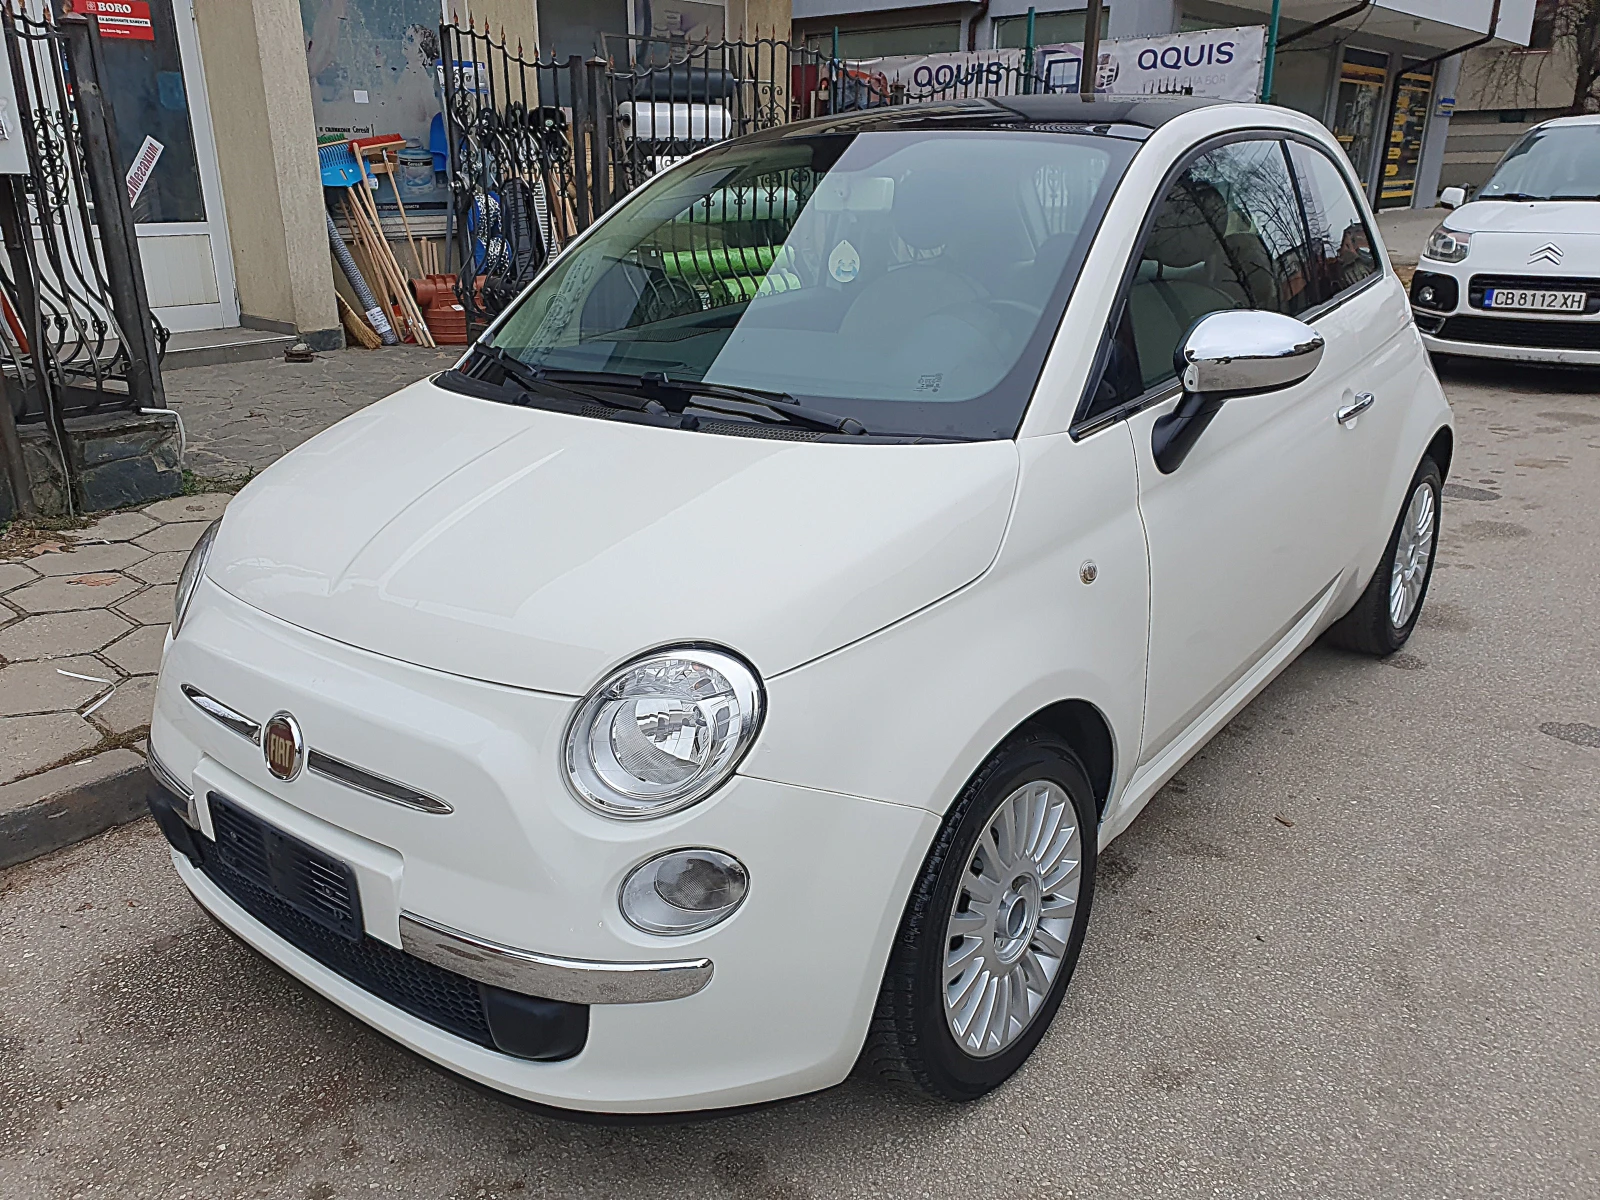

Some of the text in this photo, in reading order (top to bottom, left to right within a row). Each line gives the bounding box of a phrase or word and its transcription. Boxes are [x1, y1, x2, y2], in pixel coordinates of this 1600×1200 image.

[97, 2, 132, 13] BORO
[1494, 291, 1583, 309] CB 8112 XH
[271, 733, 293, 768] FIAT
